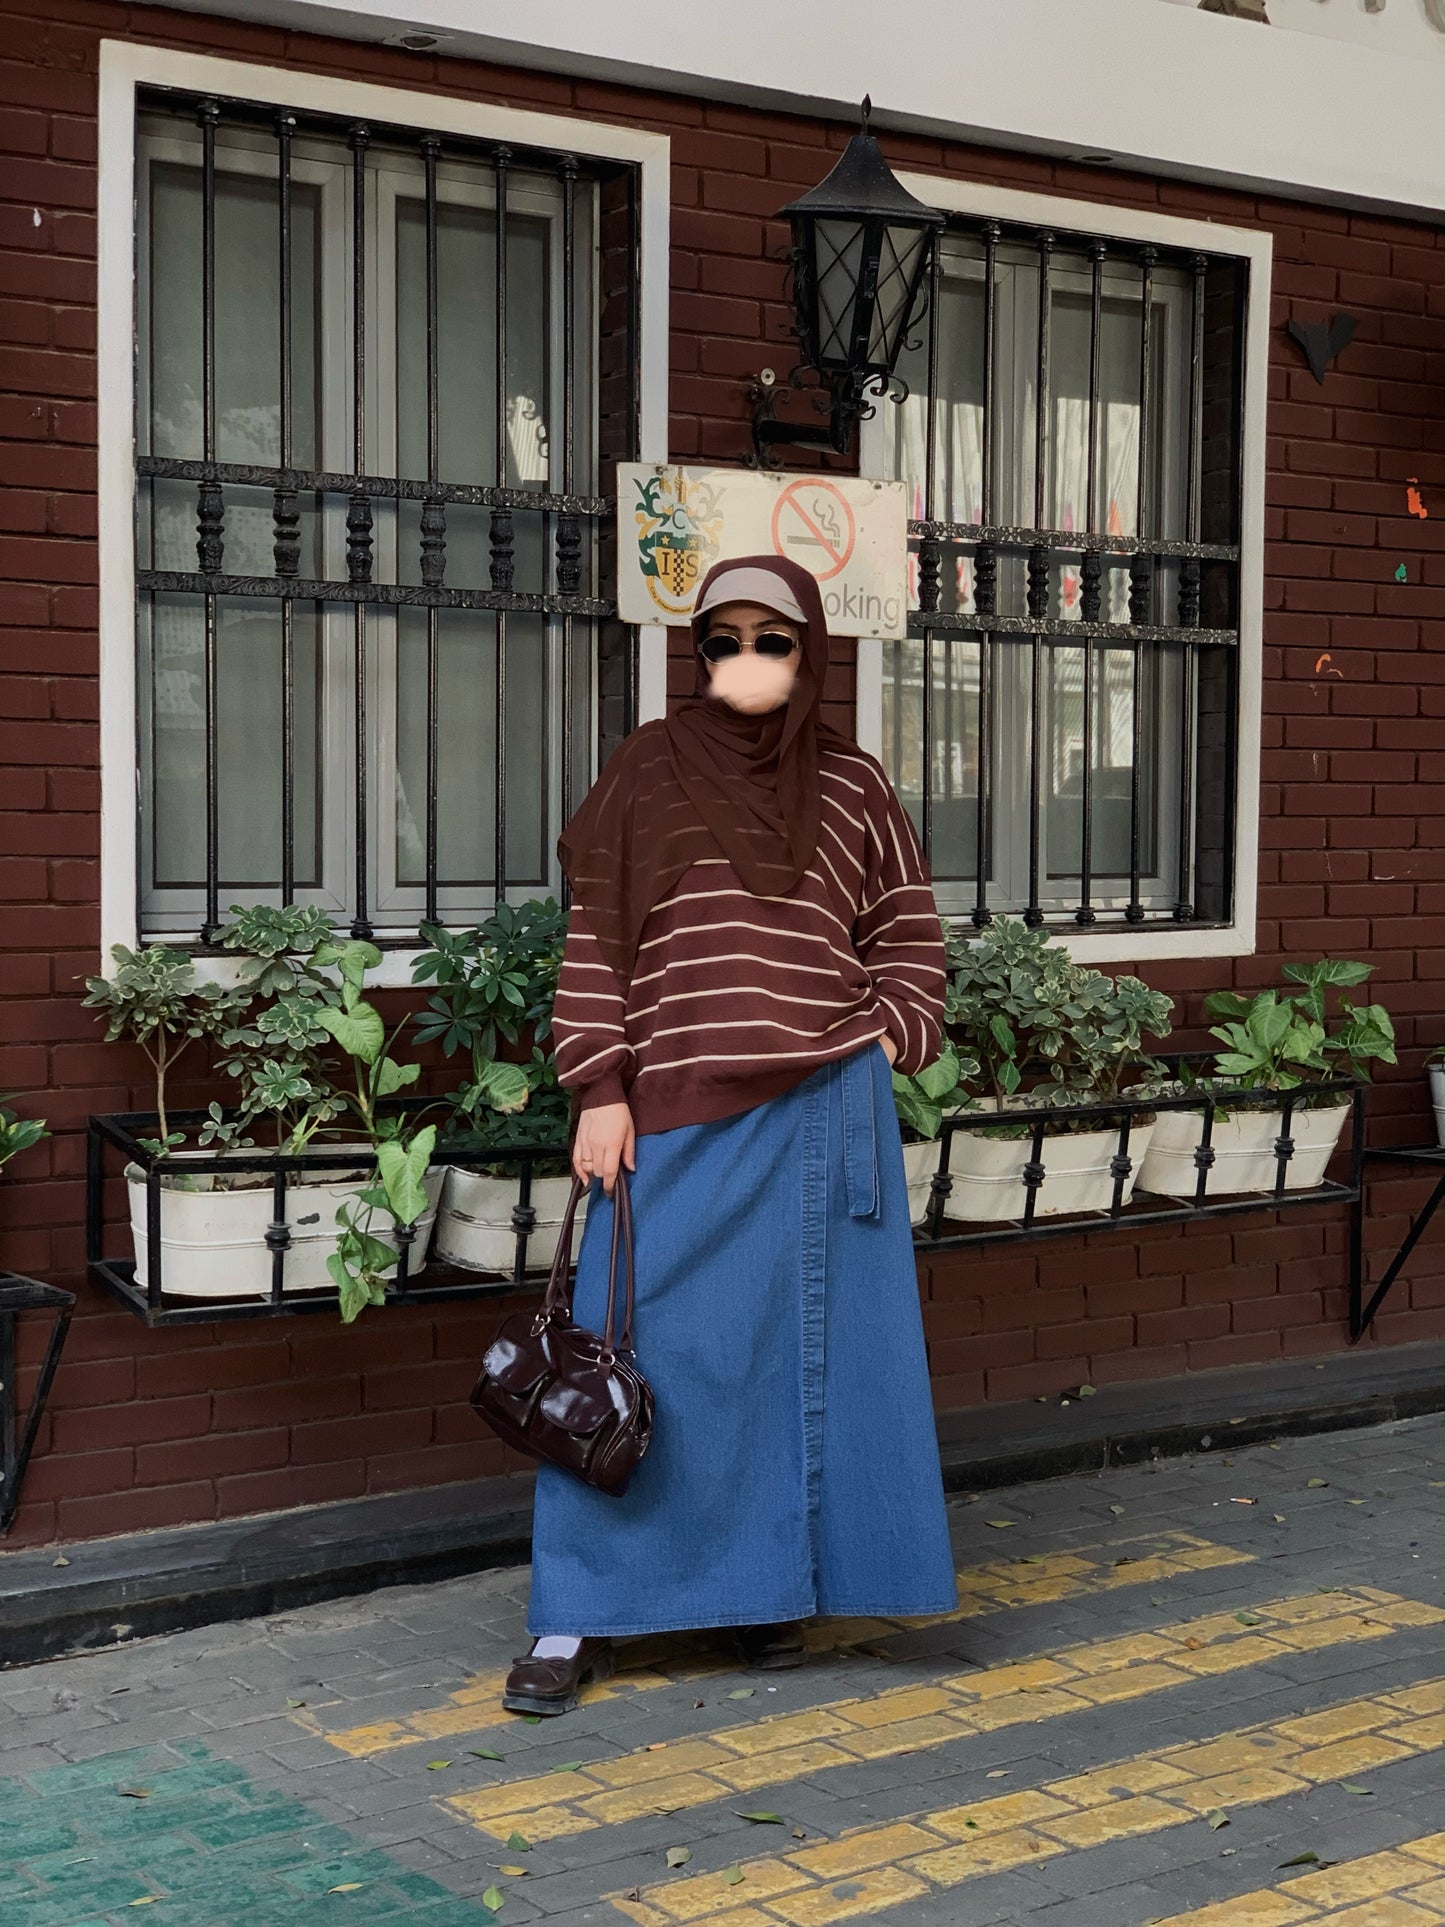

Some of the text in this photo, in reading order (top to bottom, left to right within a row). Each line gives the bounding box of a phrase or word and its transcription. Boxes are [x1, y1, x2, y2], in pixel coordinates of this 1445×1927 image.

[672, 508, 686, 530] C
[661, 551, 699, 578] I S
[824, 583, 900, 630] oking
